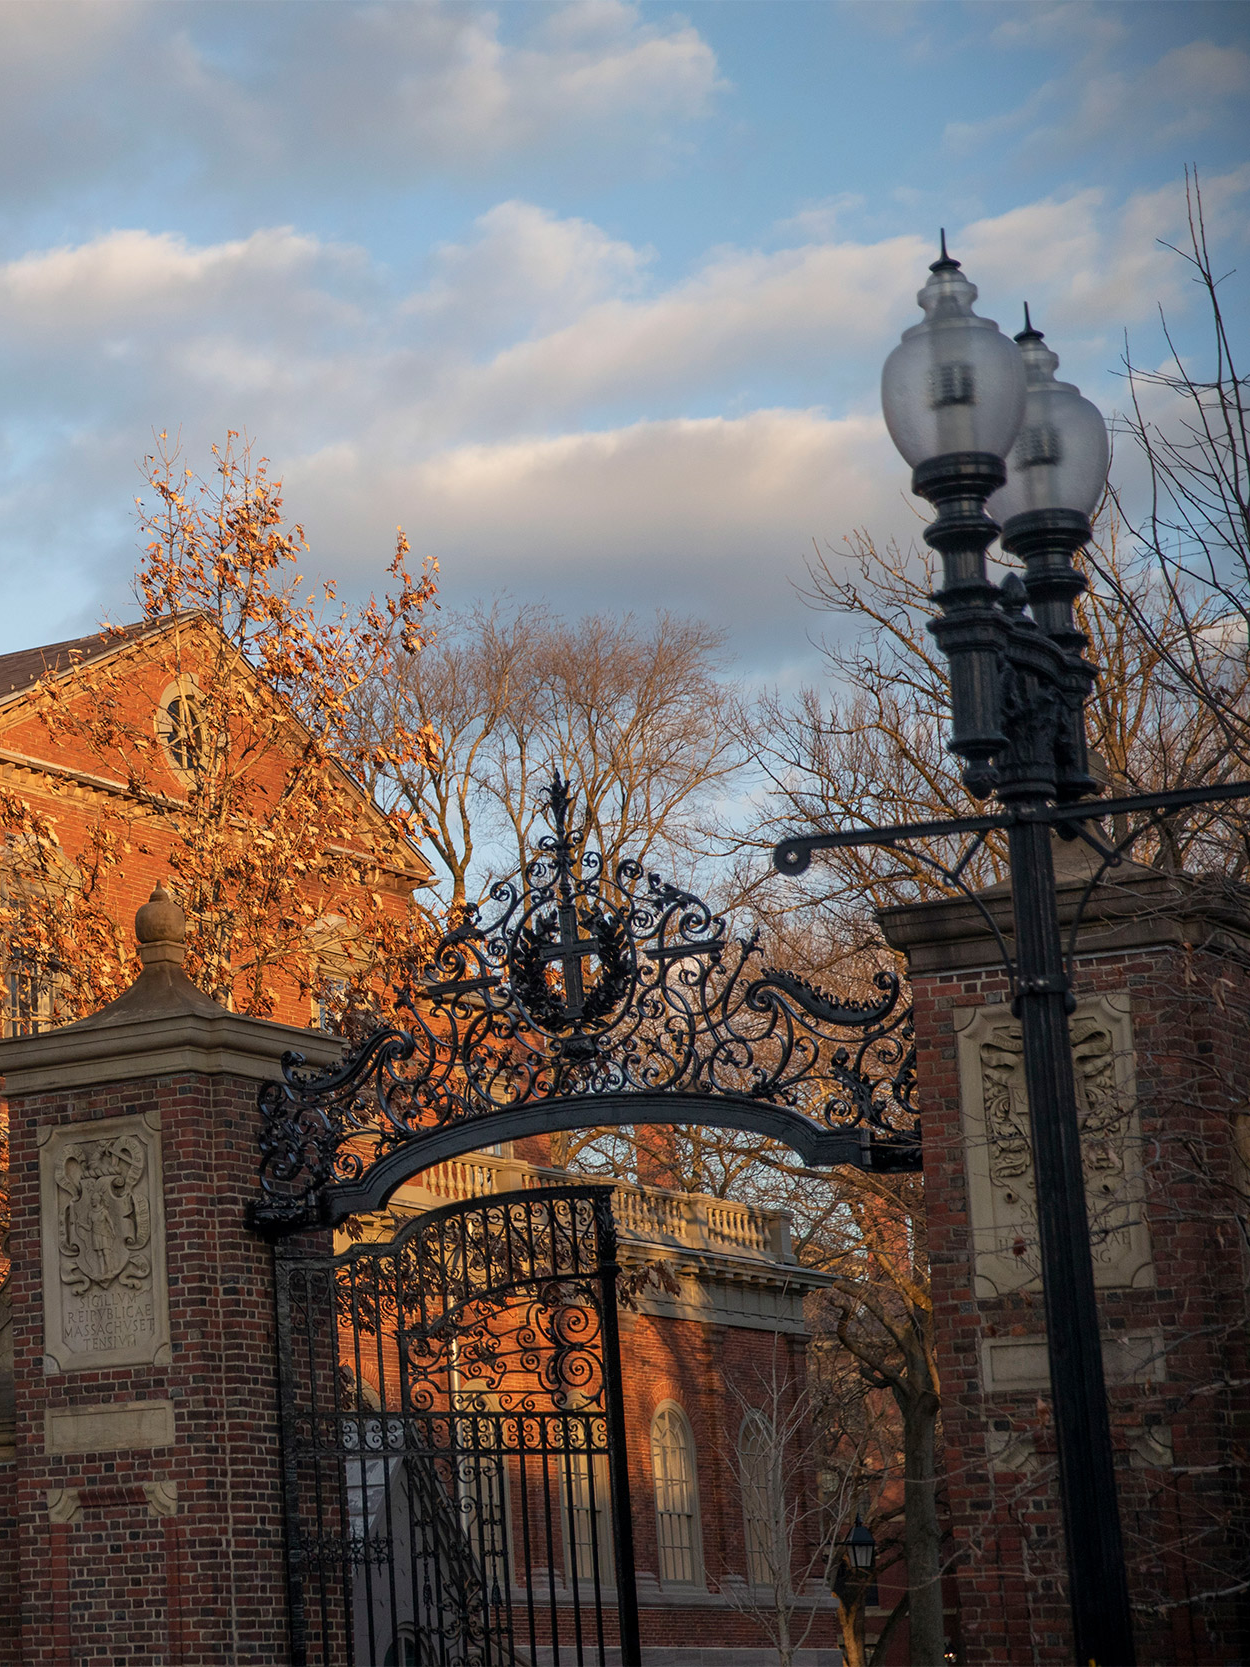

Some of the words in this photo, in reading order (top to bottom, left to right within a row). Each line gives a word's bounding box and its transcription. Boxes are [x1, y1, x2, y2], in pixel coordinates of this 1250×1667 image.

[79, 1292, 136, 1309] SIGILLVM
[67, 1303, 151, 1325] REIPVBLICAE
[64, 1318, 154, 1340] MASSACHVSET
[83, 1334, 136, 1352] TENSIVM
